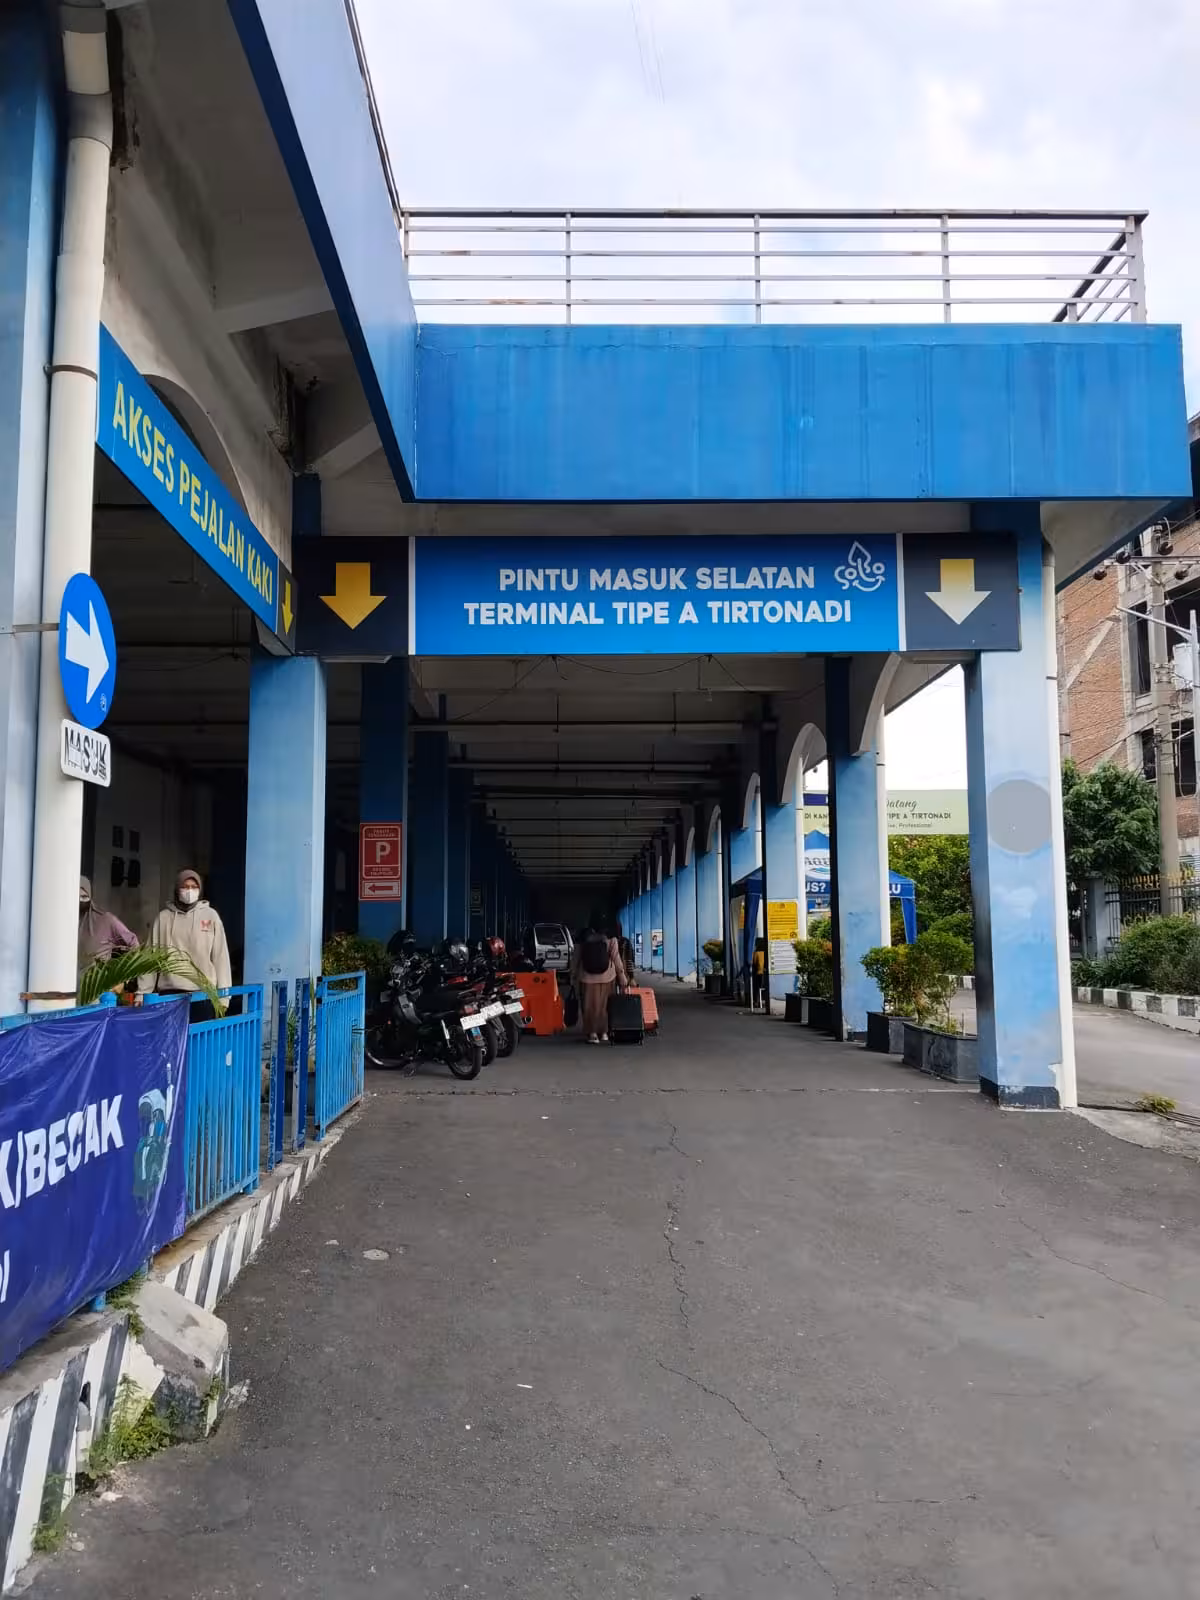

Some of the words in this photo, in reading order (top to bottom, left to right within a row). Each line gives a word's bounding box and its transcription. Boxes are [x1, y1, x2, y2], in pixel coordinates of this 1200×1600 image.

[112, 380, 175, 493] AKSES
[179, 458, 244, 573] PEJALAN
[247, 542, 273, 606] KAKI
[499, 568, 580, 592] PINTU
[589, 568, 687, 591] MASUK
[695, 566, 815, 590] SELATAN
[464, 602, 604, 626] TERMINAL
[612, 601, 670, 625] TIPE
[678, 601, 699, 624] A
[708, 599, 852, 624] TIRTONADI
[911, 812, 952, 820] TIRTONADI
[375, 841, 391, 864] P
